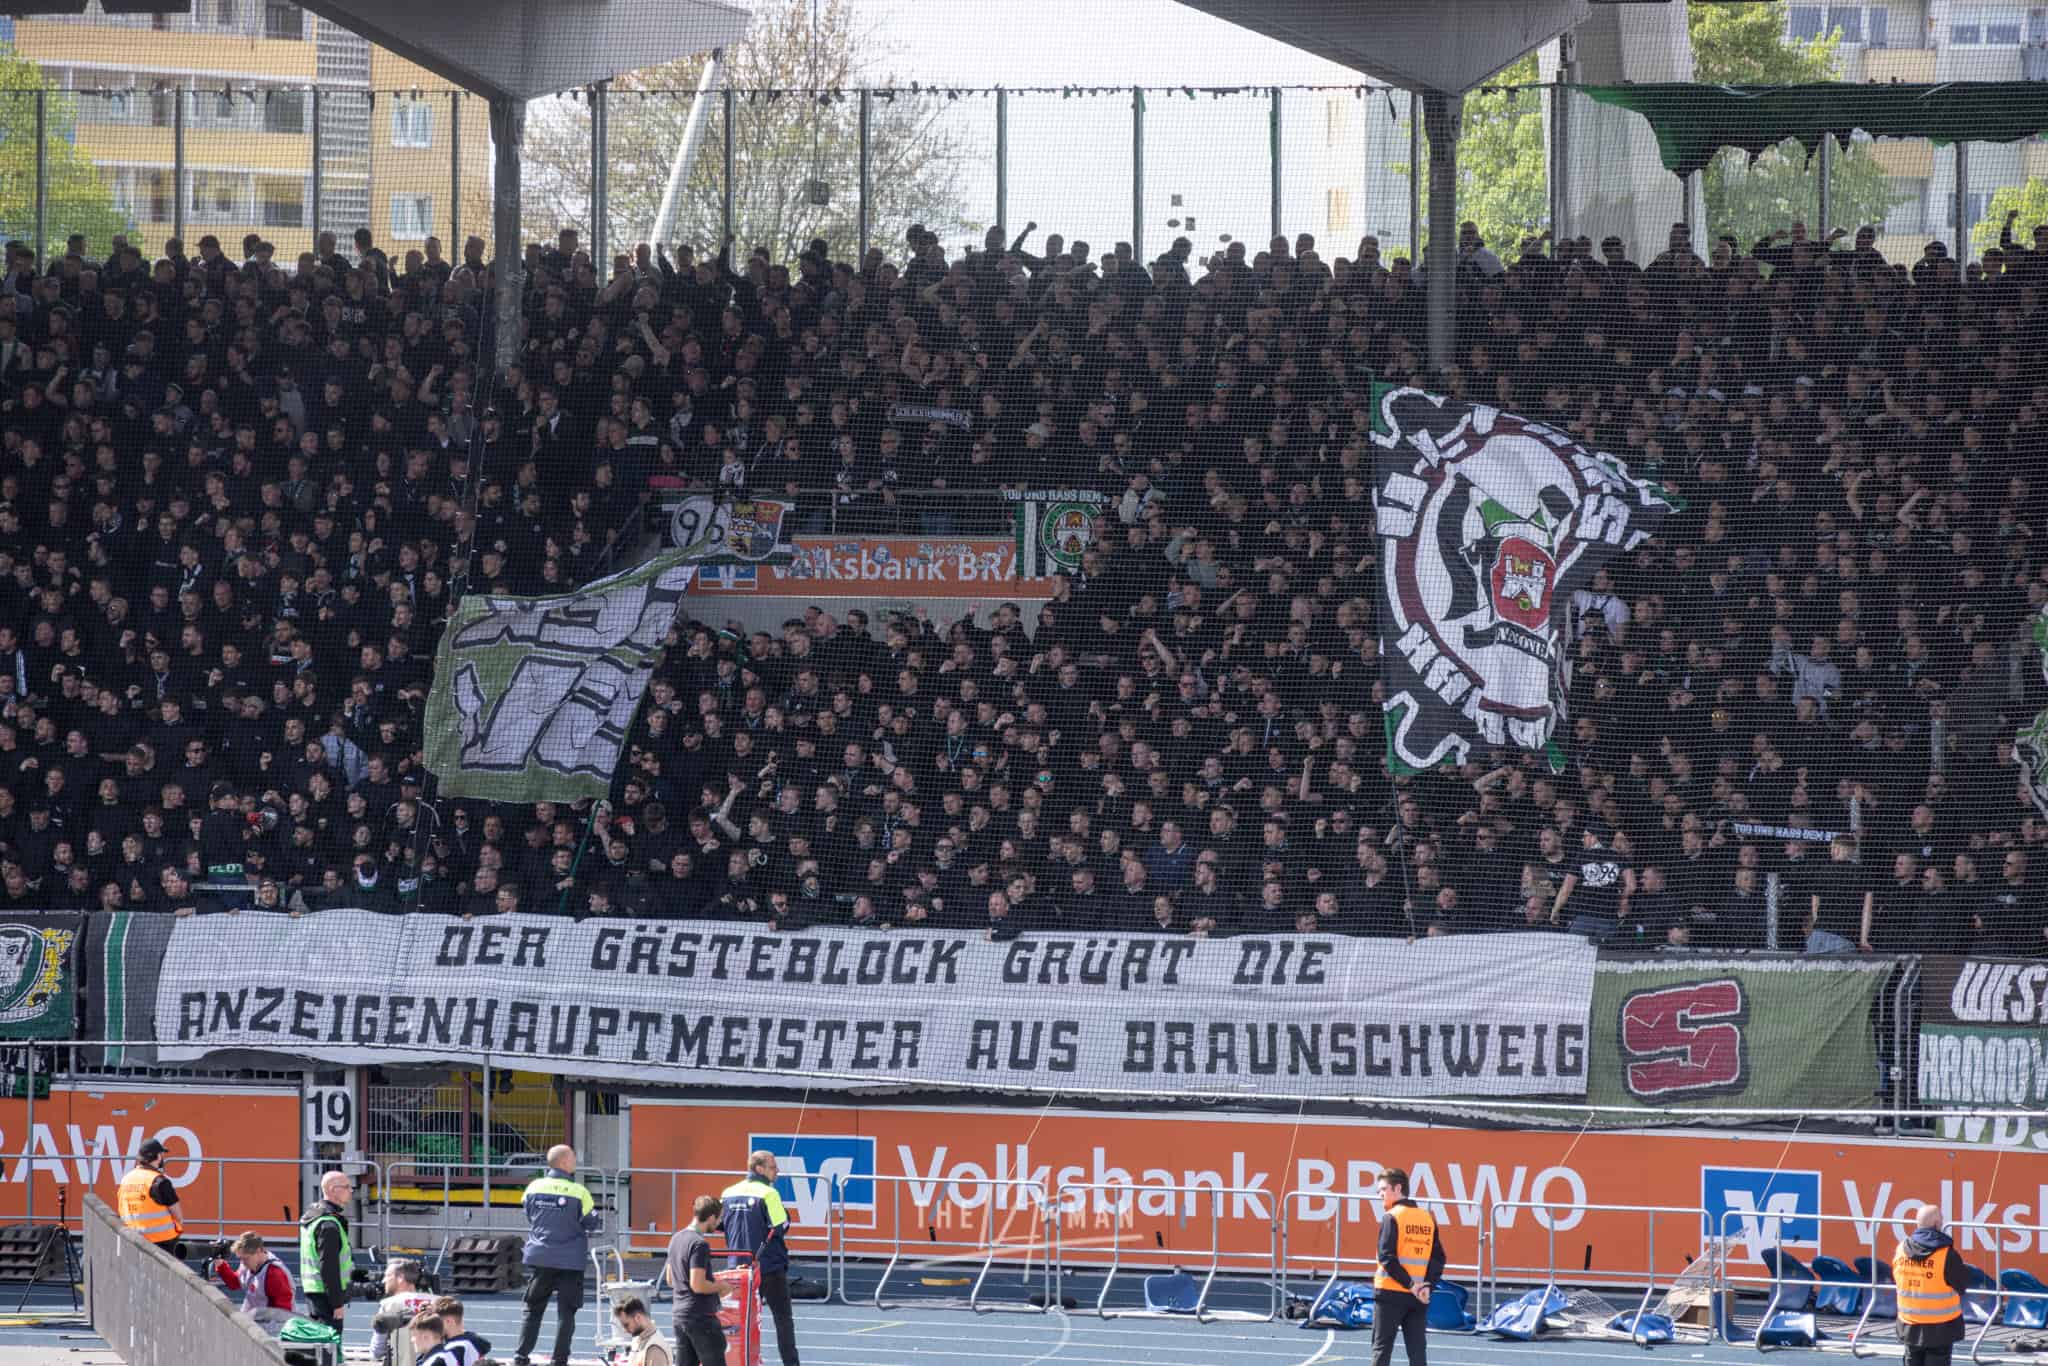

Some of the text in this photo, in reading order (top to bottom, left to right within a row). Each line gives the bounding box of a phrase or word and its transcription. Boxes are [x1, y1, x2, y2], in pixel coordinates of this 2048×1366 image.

[677, 504, 725, 549] 96
[772, 547, 946, 582] Vlksbank
[436, 925, 551, 968] DER
[591, 925, 967, 985] GÄSTEBLOCK
[1233, 940, 1333, 985] DIE
[178, 987, 1584, 1077] ANZEIGENHAUPTMEISTER AUS BRAUNSCHWEIG
[306, 1090, 352, 1137] 19
[0, 1122, 203, 1189] AWO
[896, 1143, 1587, 1232] Volksbank BRAWO
